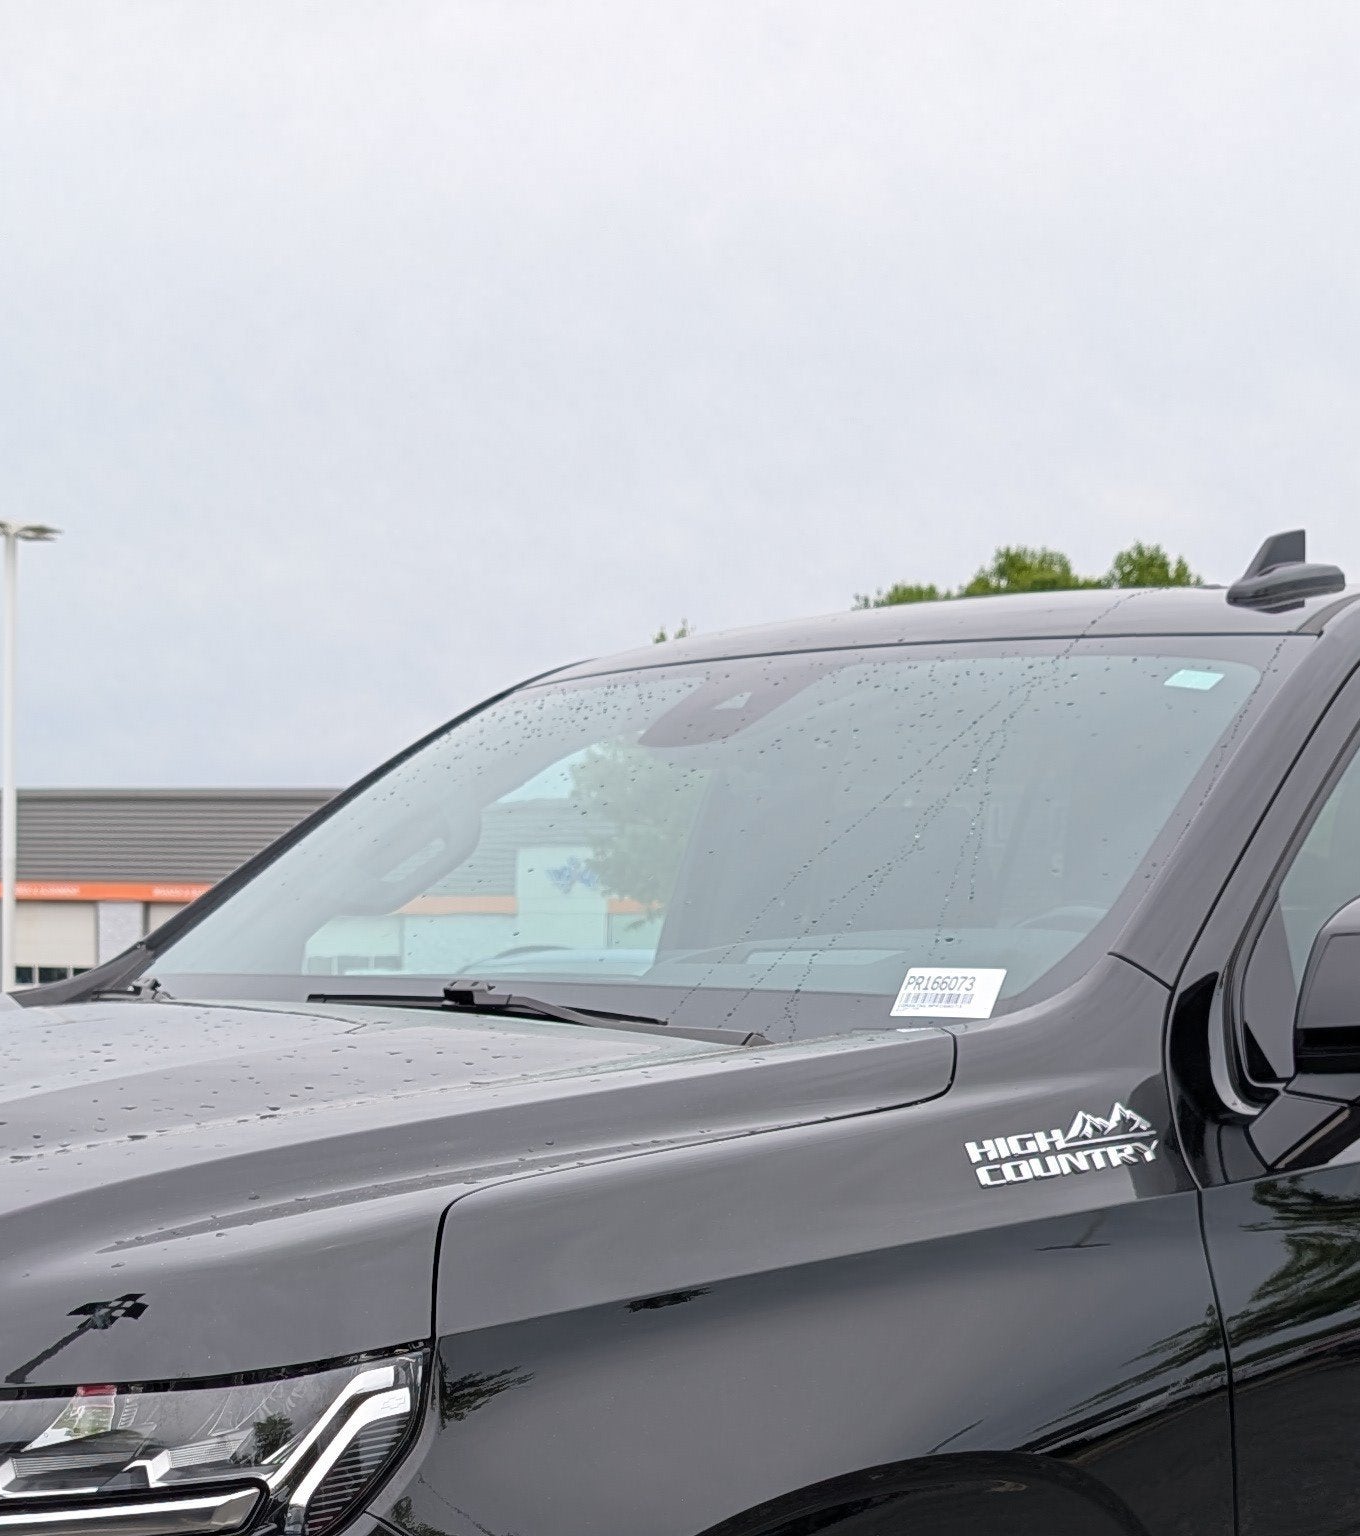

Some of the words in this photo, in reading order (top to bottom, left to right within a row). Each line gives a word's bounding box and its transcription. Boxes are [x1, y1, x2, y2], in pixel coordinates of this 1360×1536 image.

[904, 975, 977, 992] PR166073
[965, 1129, 1067, 1164] HIGH
[975, 1140, 1159, 1187] COUNTRY
